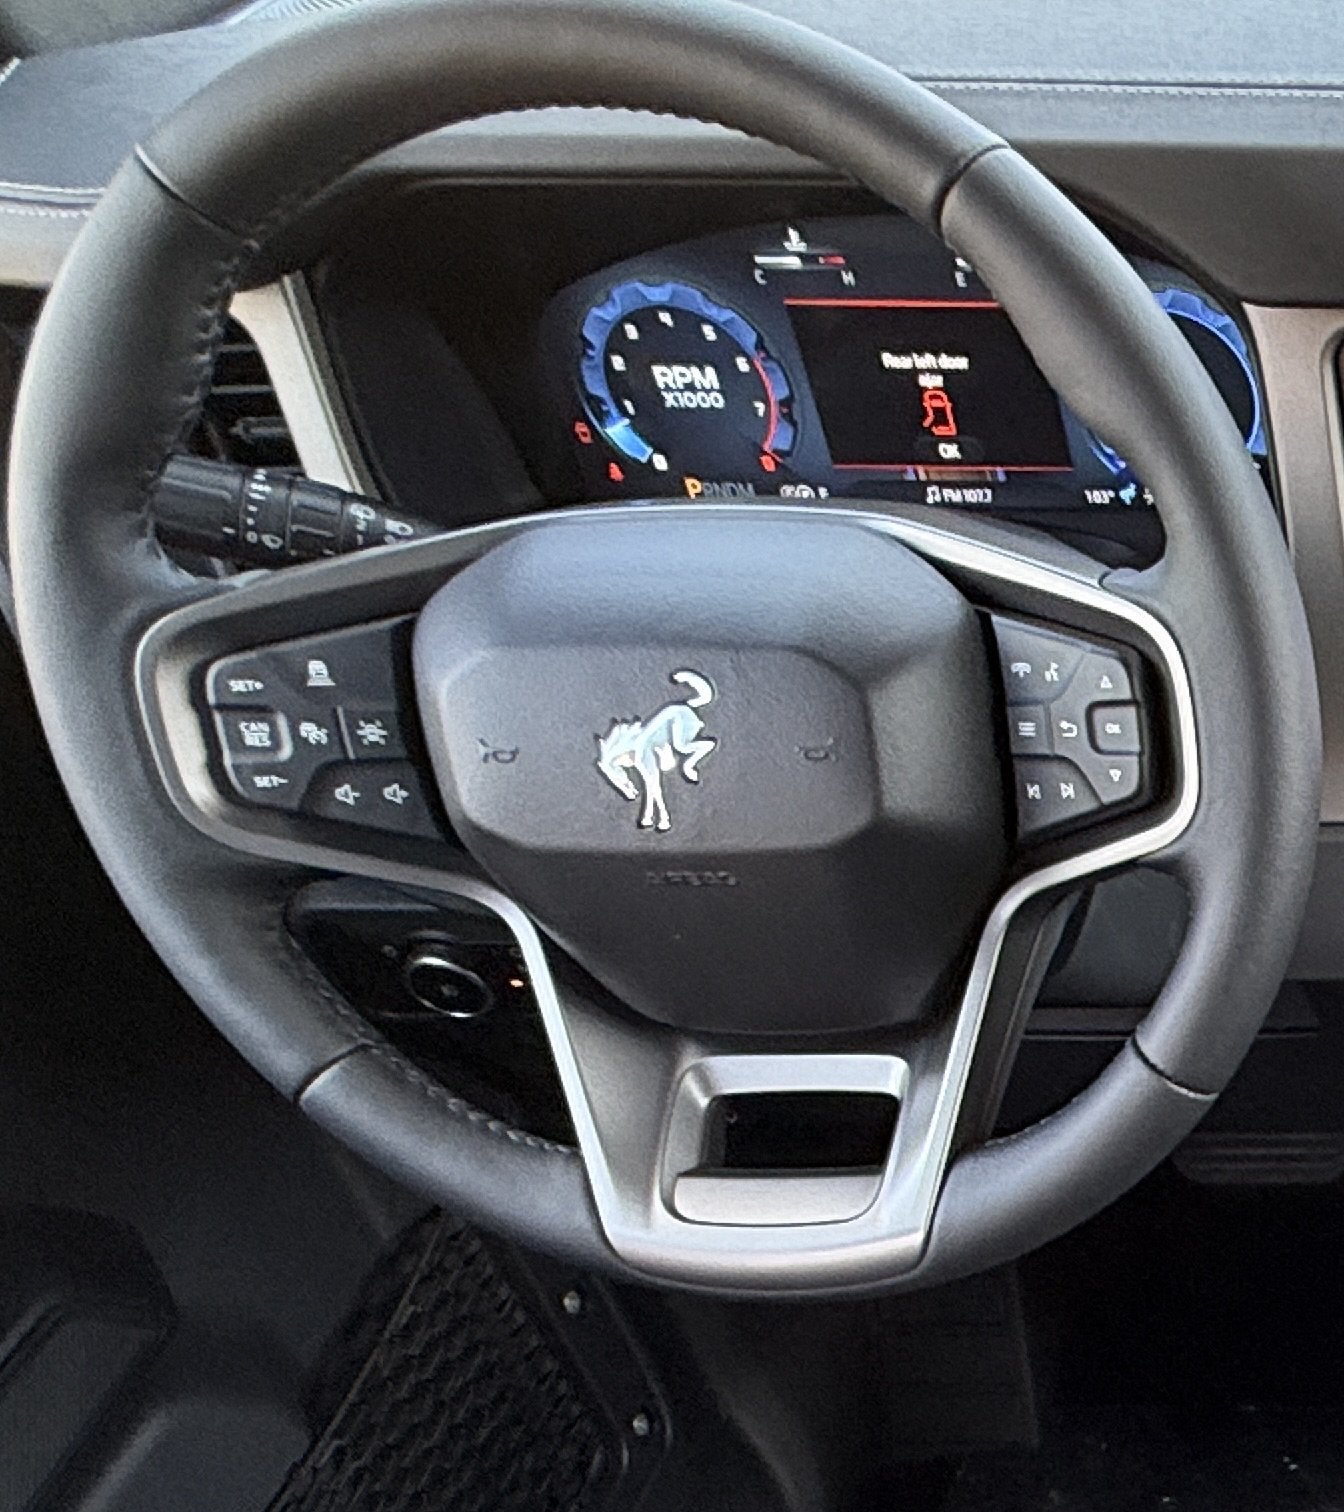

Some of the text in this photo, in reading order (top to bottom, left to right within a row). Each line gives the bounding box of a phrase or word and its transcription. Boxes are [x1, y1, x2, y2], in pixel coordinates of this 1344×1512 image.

[754, 269, 767, 284] C
[841, 269, 856, 286] H
[651, 365, 720, 390] RPM
[660, 391, 726, 409] X1000
[938, 442, 962, 459] OK
